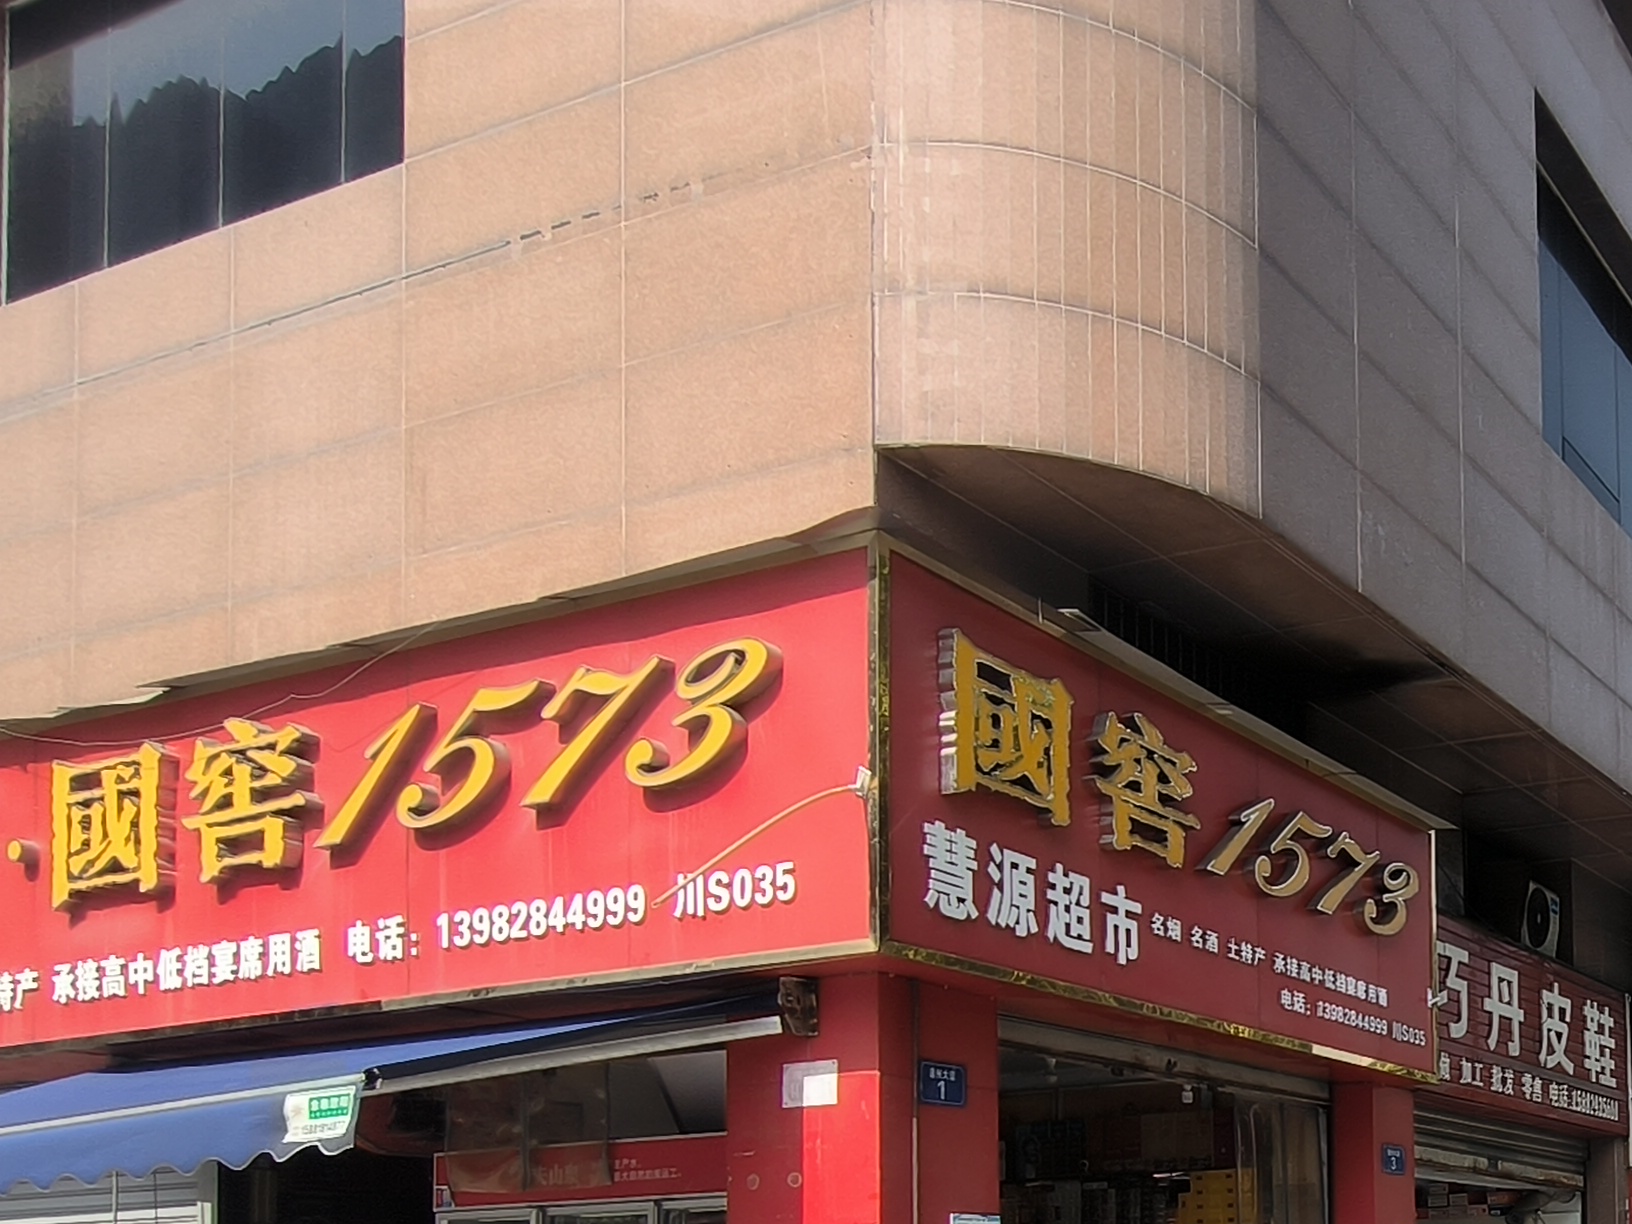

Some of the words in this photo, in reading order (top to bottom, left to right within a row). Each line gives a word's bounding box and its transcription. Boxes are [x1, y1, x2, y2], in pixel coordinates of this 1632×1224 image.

[52, 928, 322, 1005] 承接高中低档宴席用酒
[436, 882, 646, 951] 13982844999
[673, 861, 798, 920] 川S035
[923, 820, 1143, 966] 慧源超市
[1150, 911, 1182, 943] 名烟
[1190, 925, 1219, 955] 名酒
[937, 1080, 945, 1100] 1
